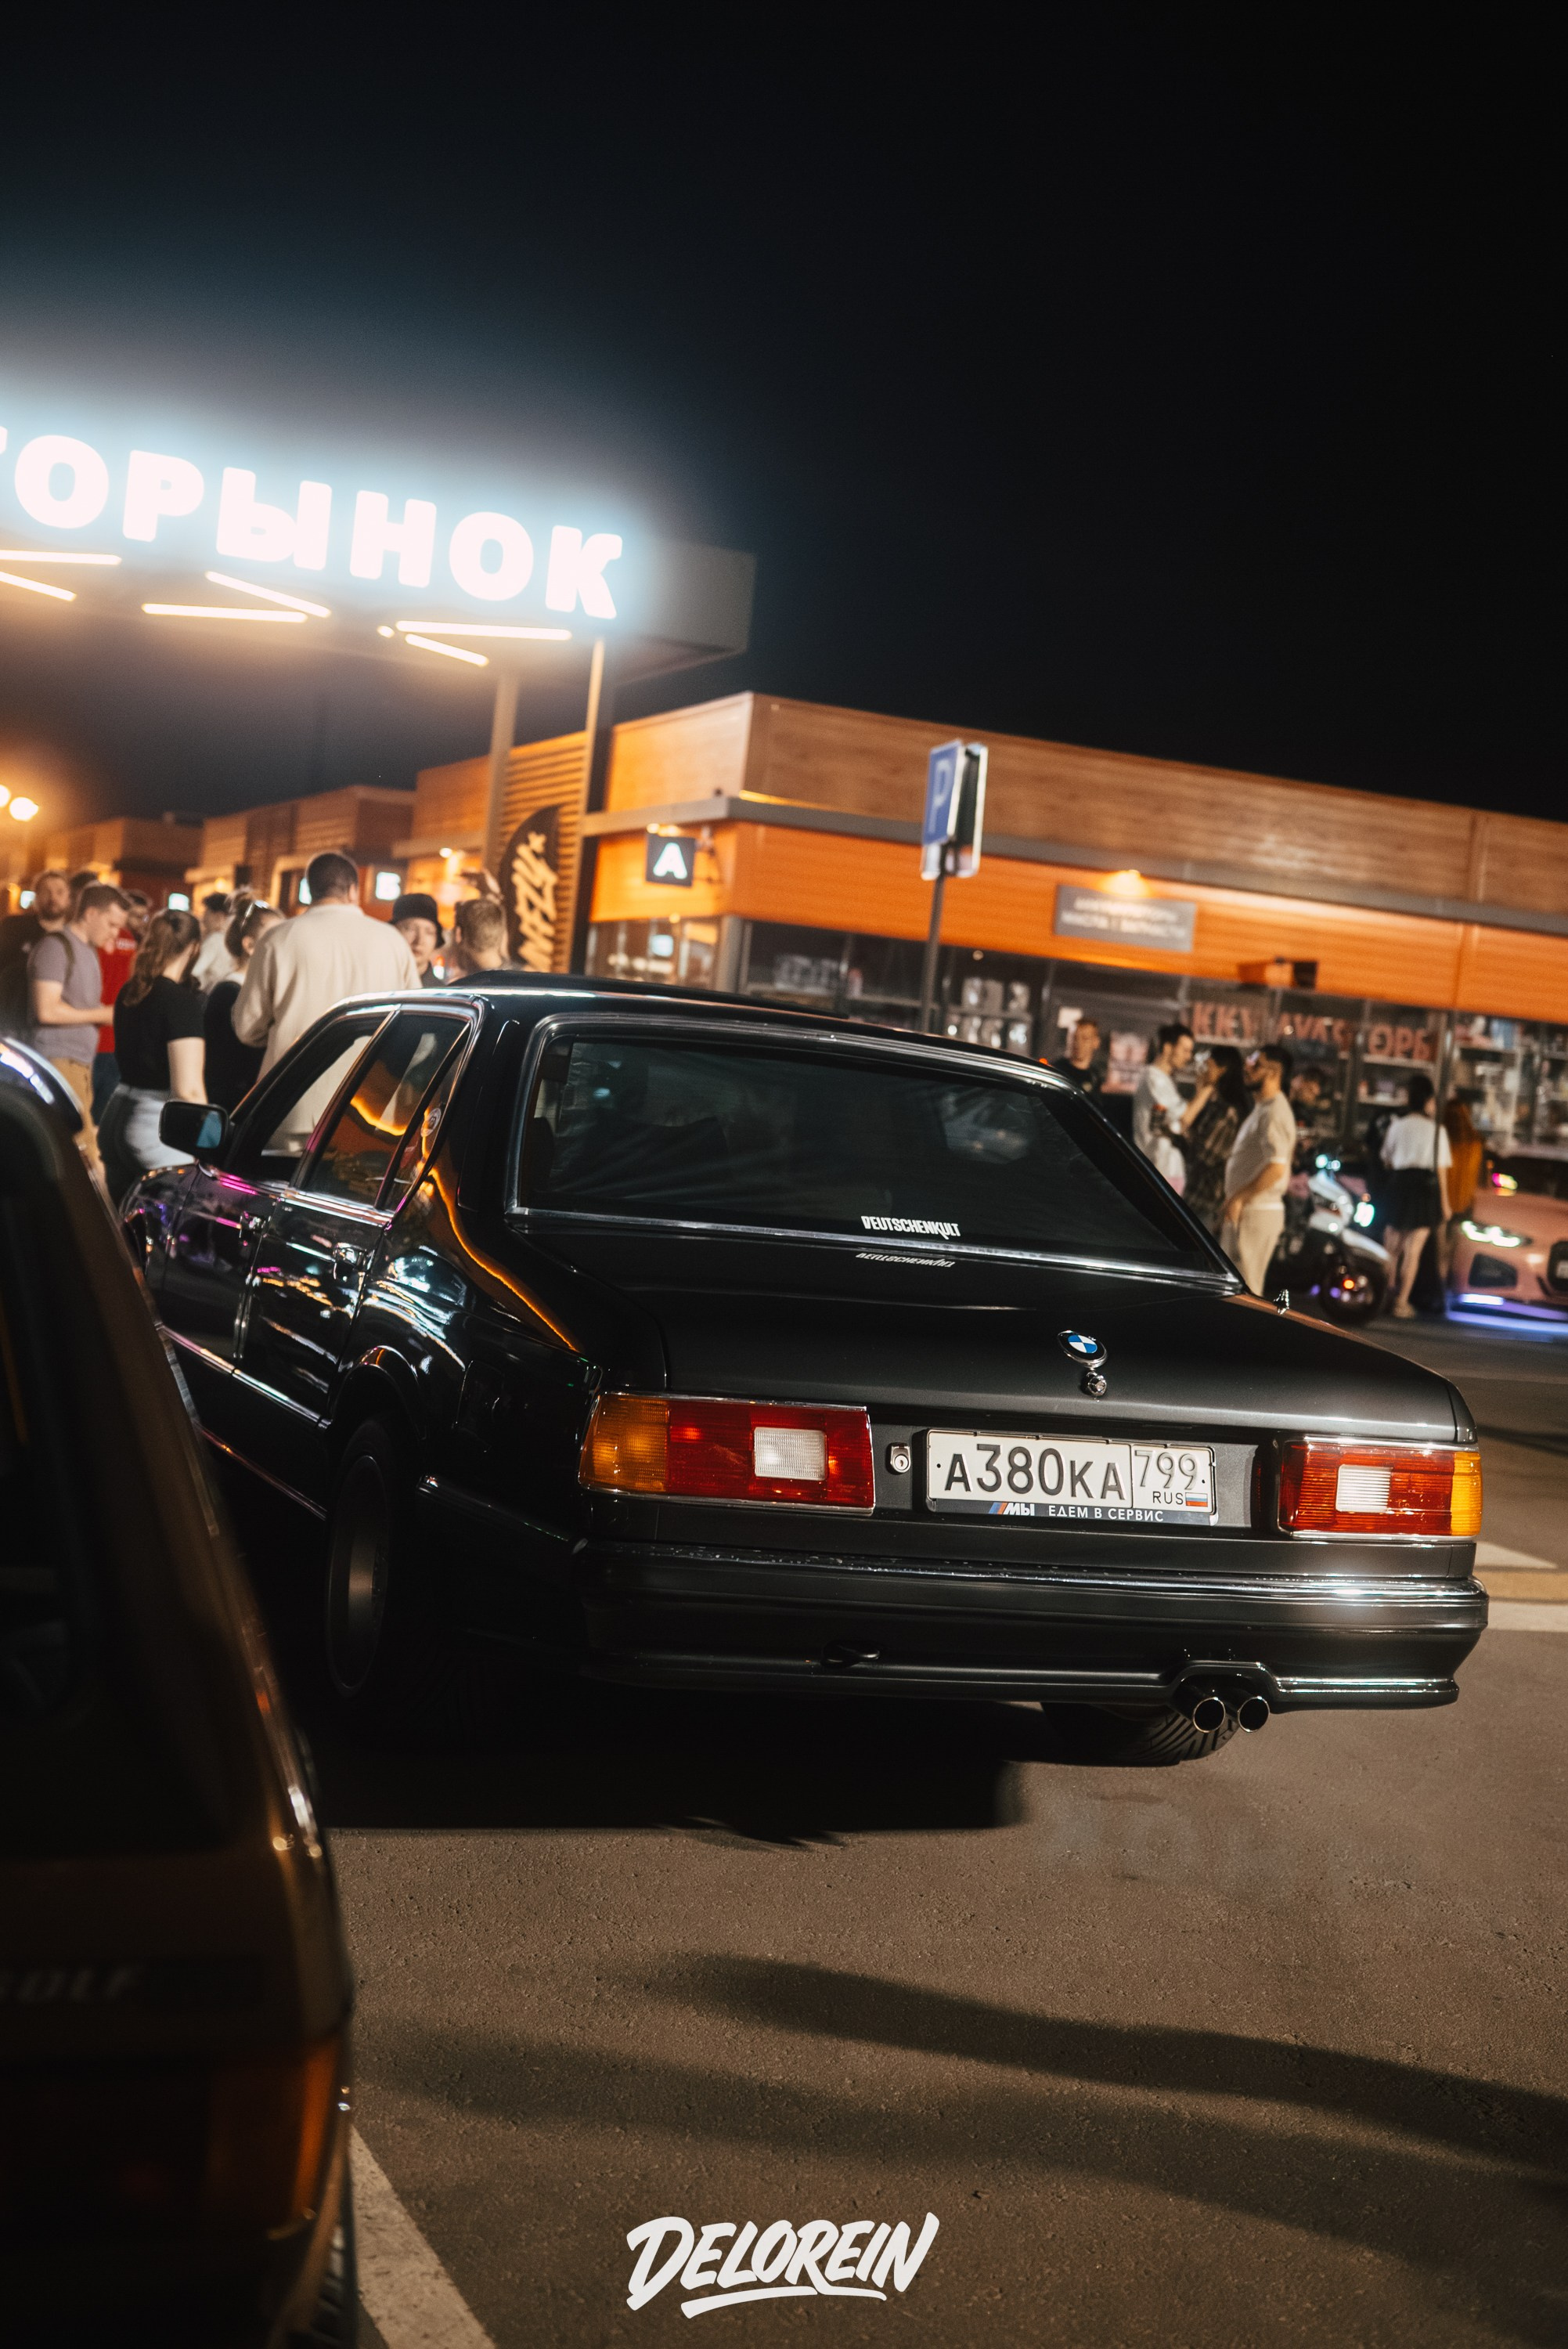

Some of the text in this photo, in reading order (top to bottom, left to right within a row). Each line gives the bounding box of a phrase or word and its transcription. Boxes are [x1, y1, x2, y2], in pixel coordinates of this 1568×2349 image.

[0, 427, 623, 619] ОРЫНОК
[861, 1215, 961, 1240] DEUTSCHENKULT
[1135, 1450, 1199, 1491] 799
[1152, 1491, 1184, 1505] RUS
[1048, 1505, 1088, 1518] ЕДЕМ
[1094, 1507, 1102, 1519] В
[1108, 1508, 1164, 1522] СЕРВИС
